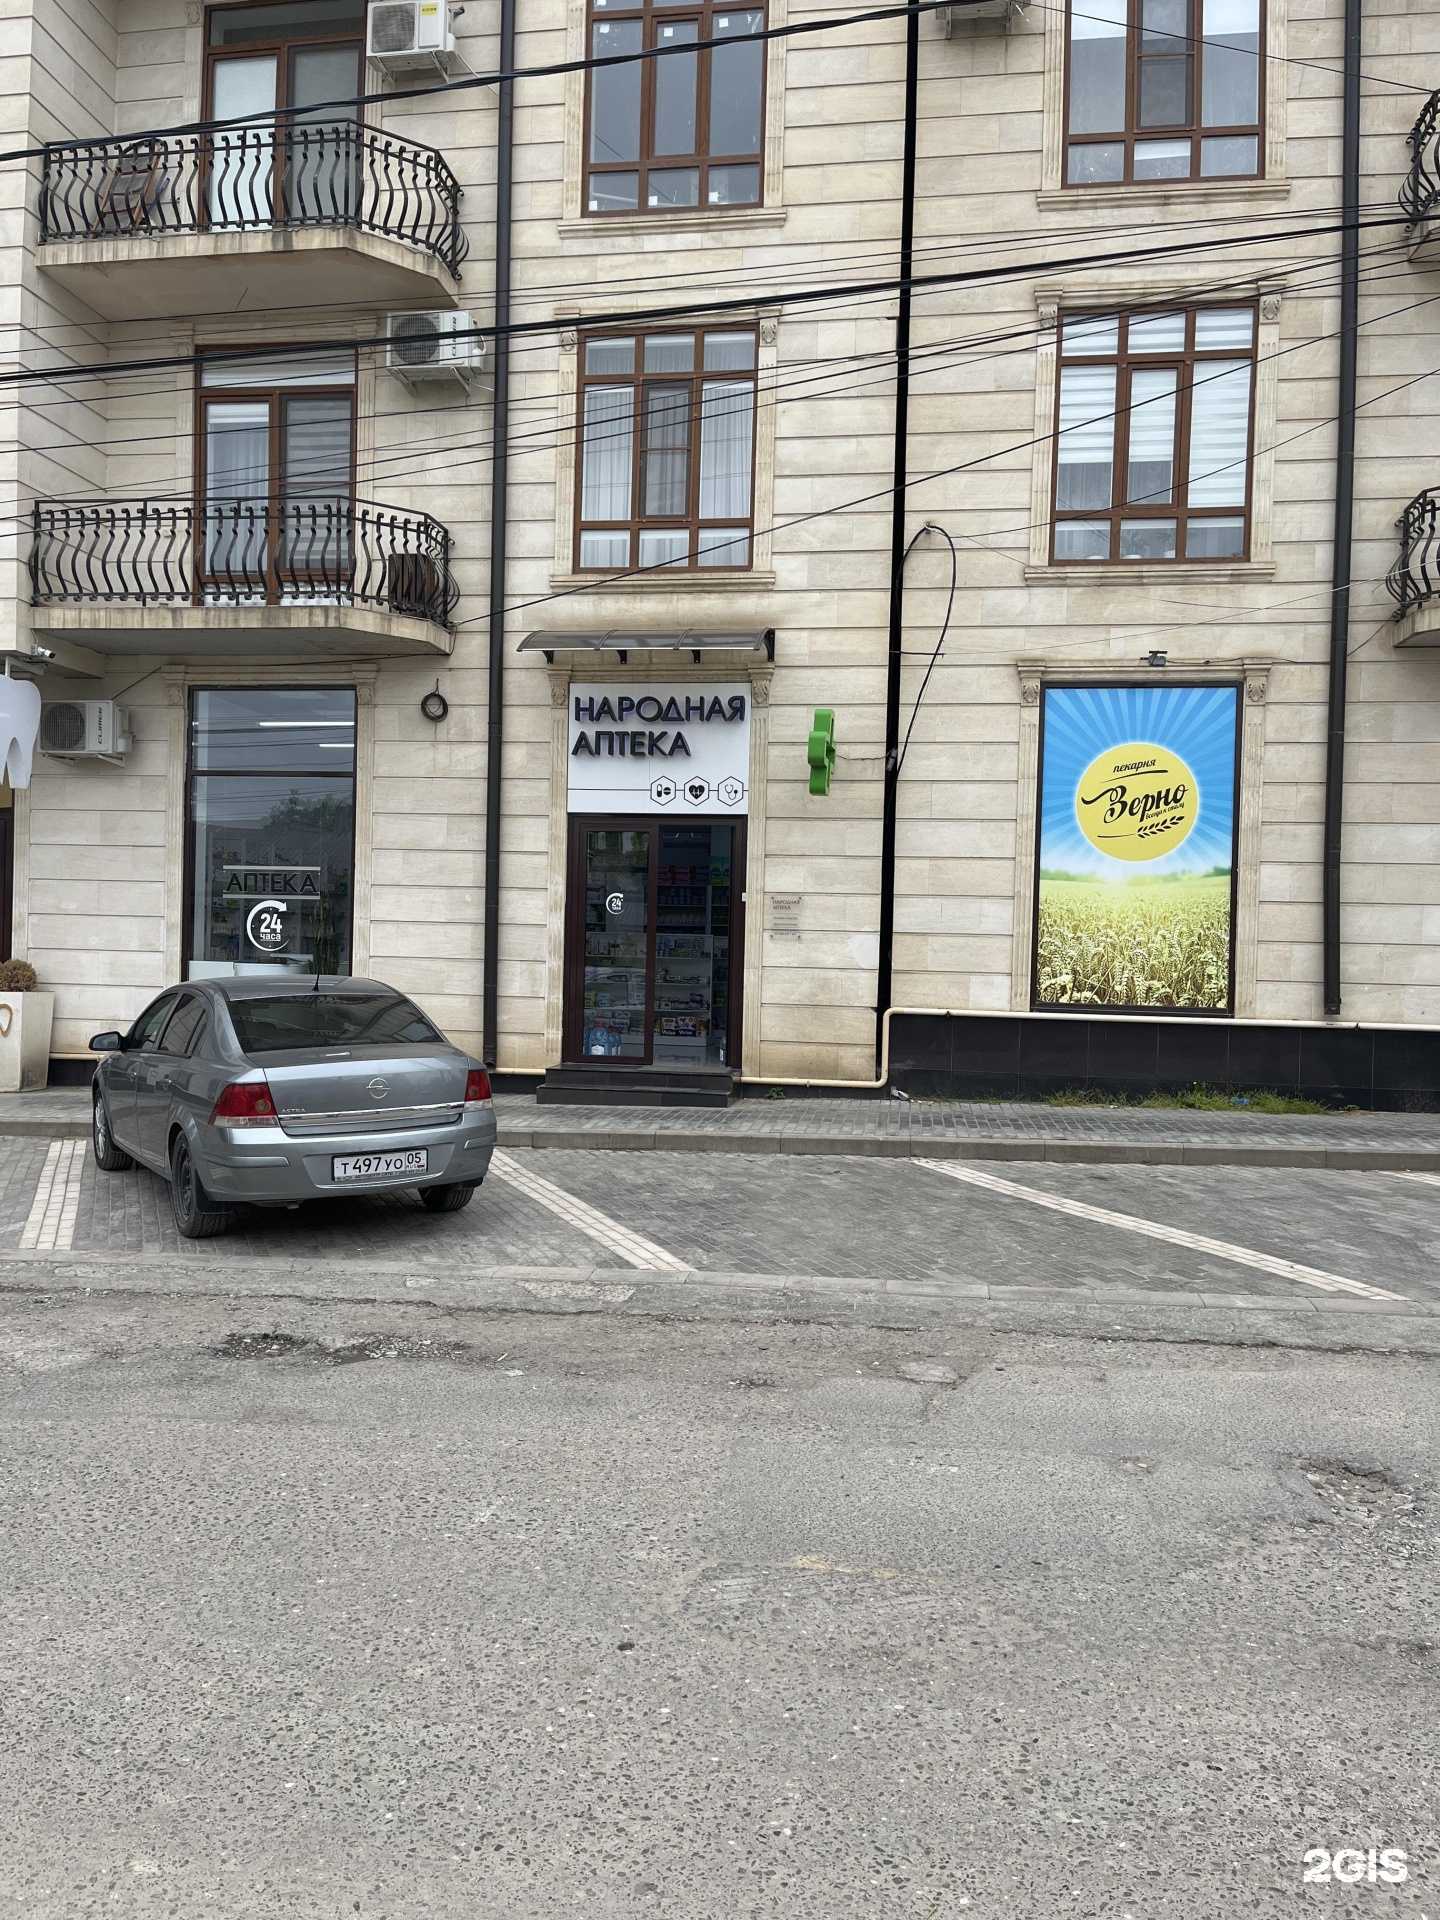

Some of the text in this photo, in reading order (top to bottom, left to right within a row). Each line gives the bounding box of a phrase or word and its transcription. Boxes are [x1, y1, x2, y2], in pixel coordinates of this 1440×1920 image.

[574, 695, 746, 722] НАРОДНАЯ
[571, 730, 692, 757] АПТЕКА
[1112, 759, 1157, 774] пекарня
[1081, 784, 1189, 824] Зерно
[226, 872, 318, 893] АПТЕКА
[611, 898, 622, 907] 24
[260, 913, 283, 934] 24
[260, 933, 281, 941] часа
[407, 1152, 422, 1165] 05
